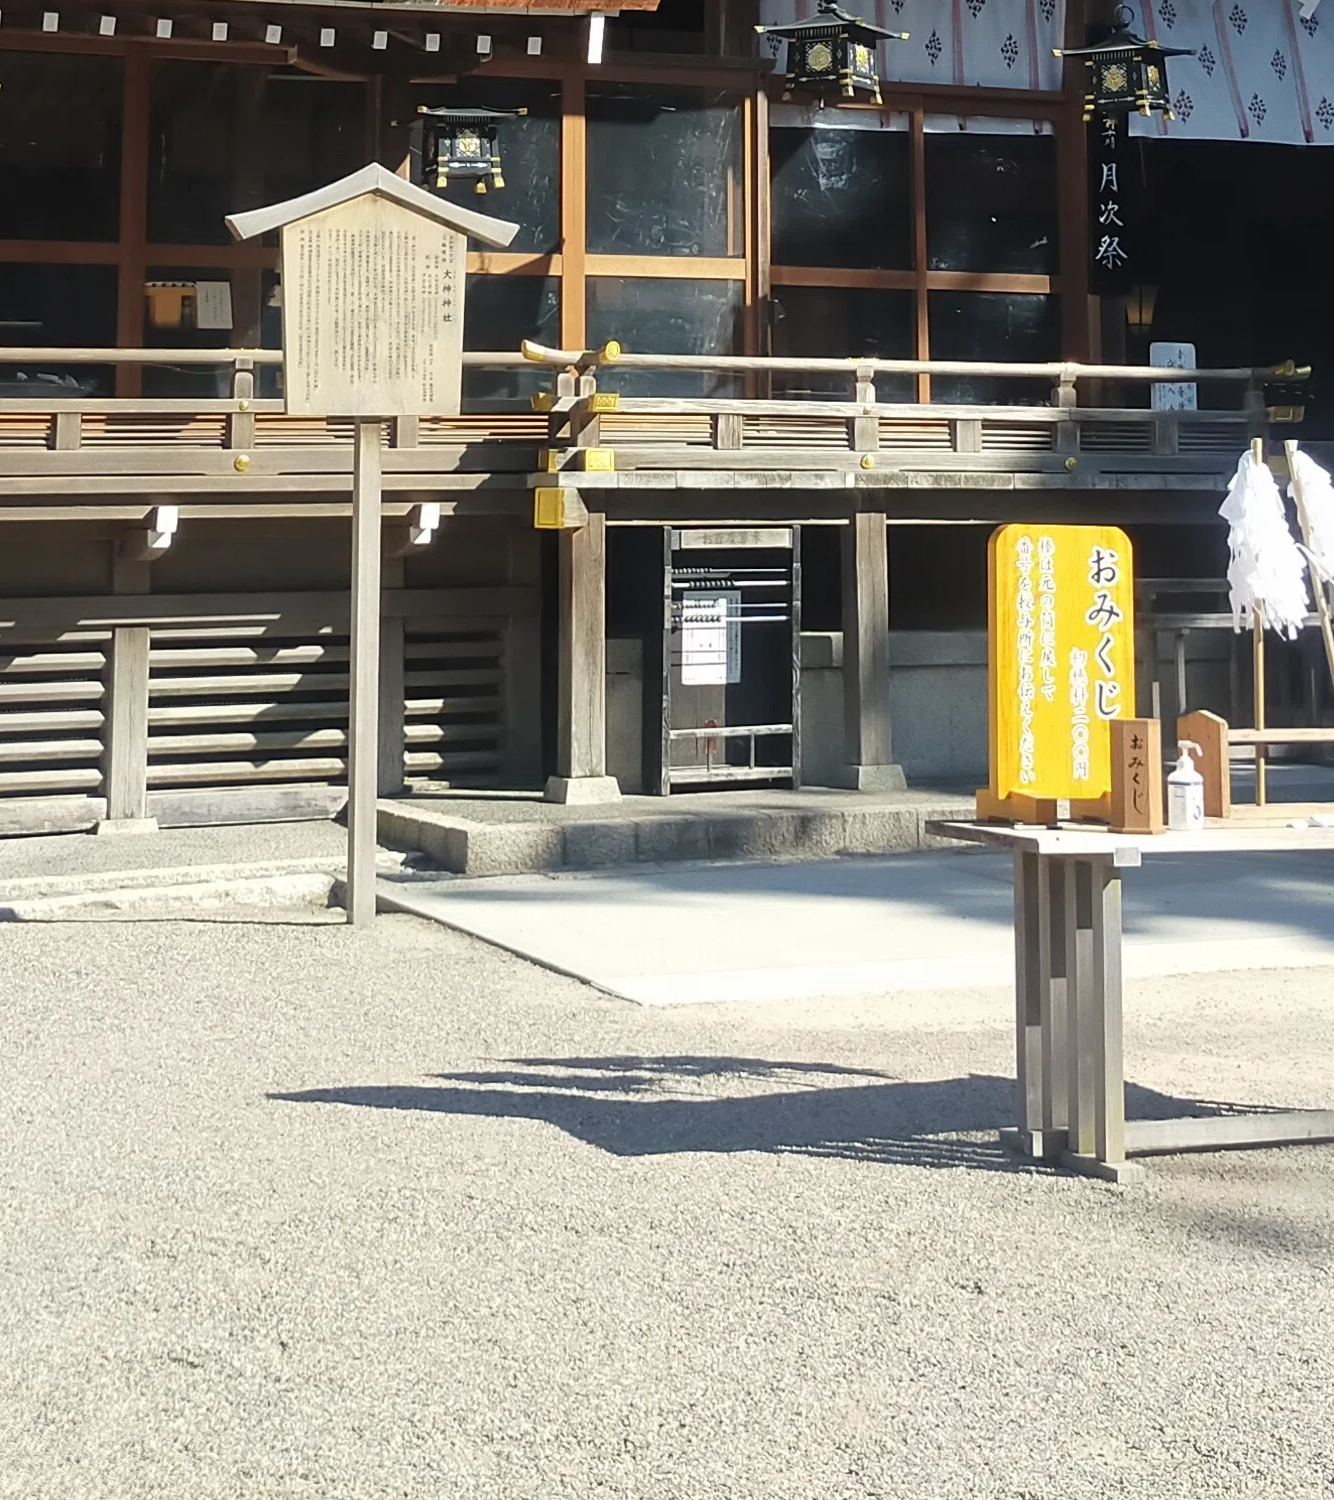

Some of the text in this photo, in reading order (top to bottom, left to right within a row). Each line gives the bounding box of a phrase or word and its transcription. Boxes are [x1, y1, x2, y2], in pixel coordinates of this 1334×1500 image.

[1094, 162, 1128, 270] 月次祭
[441, 268, 453, 323] 大神神社
[1017, 536, 1035, 783] 番号を授与所にお伝えください
[1088, 548, 1120, 716] おみくじ
[1128, 734, 1144, 816] おみくじ
